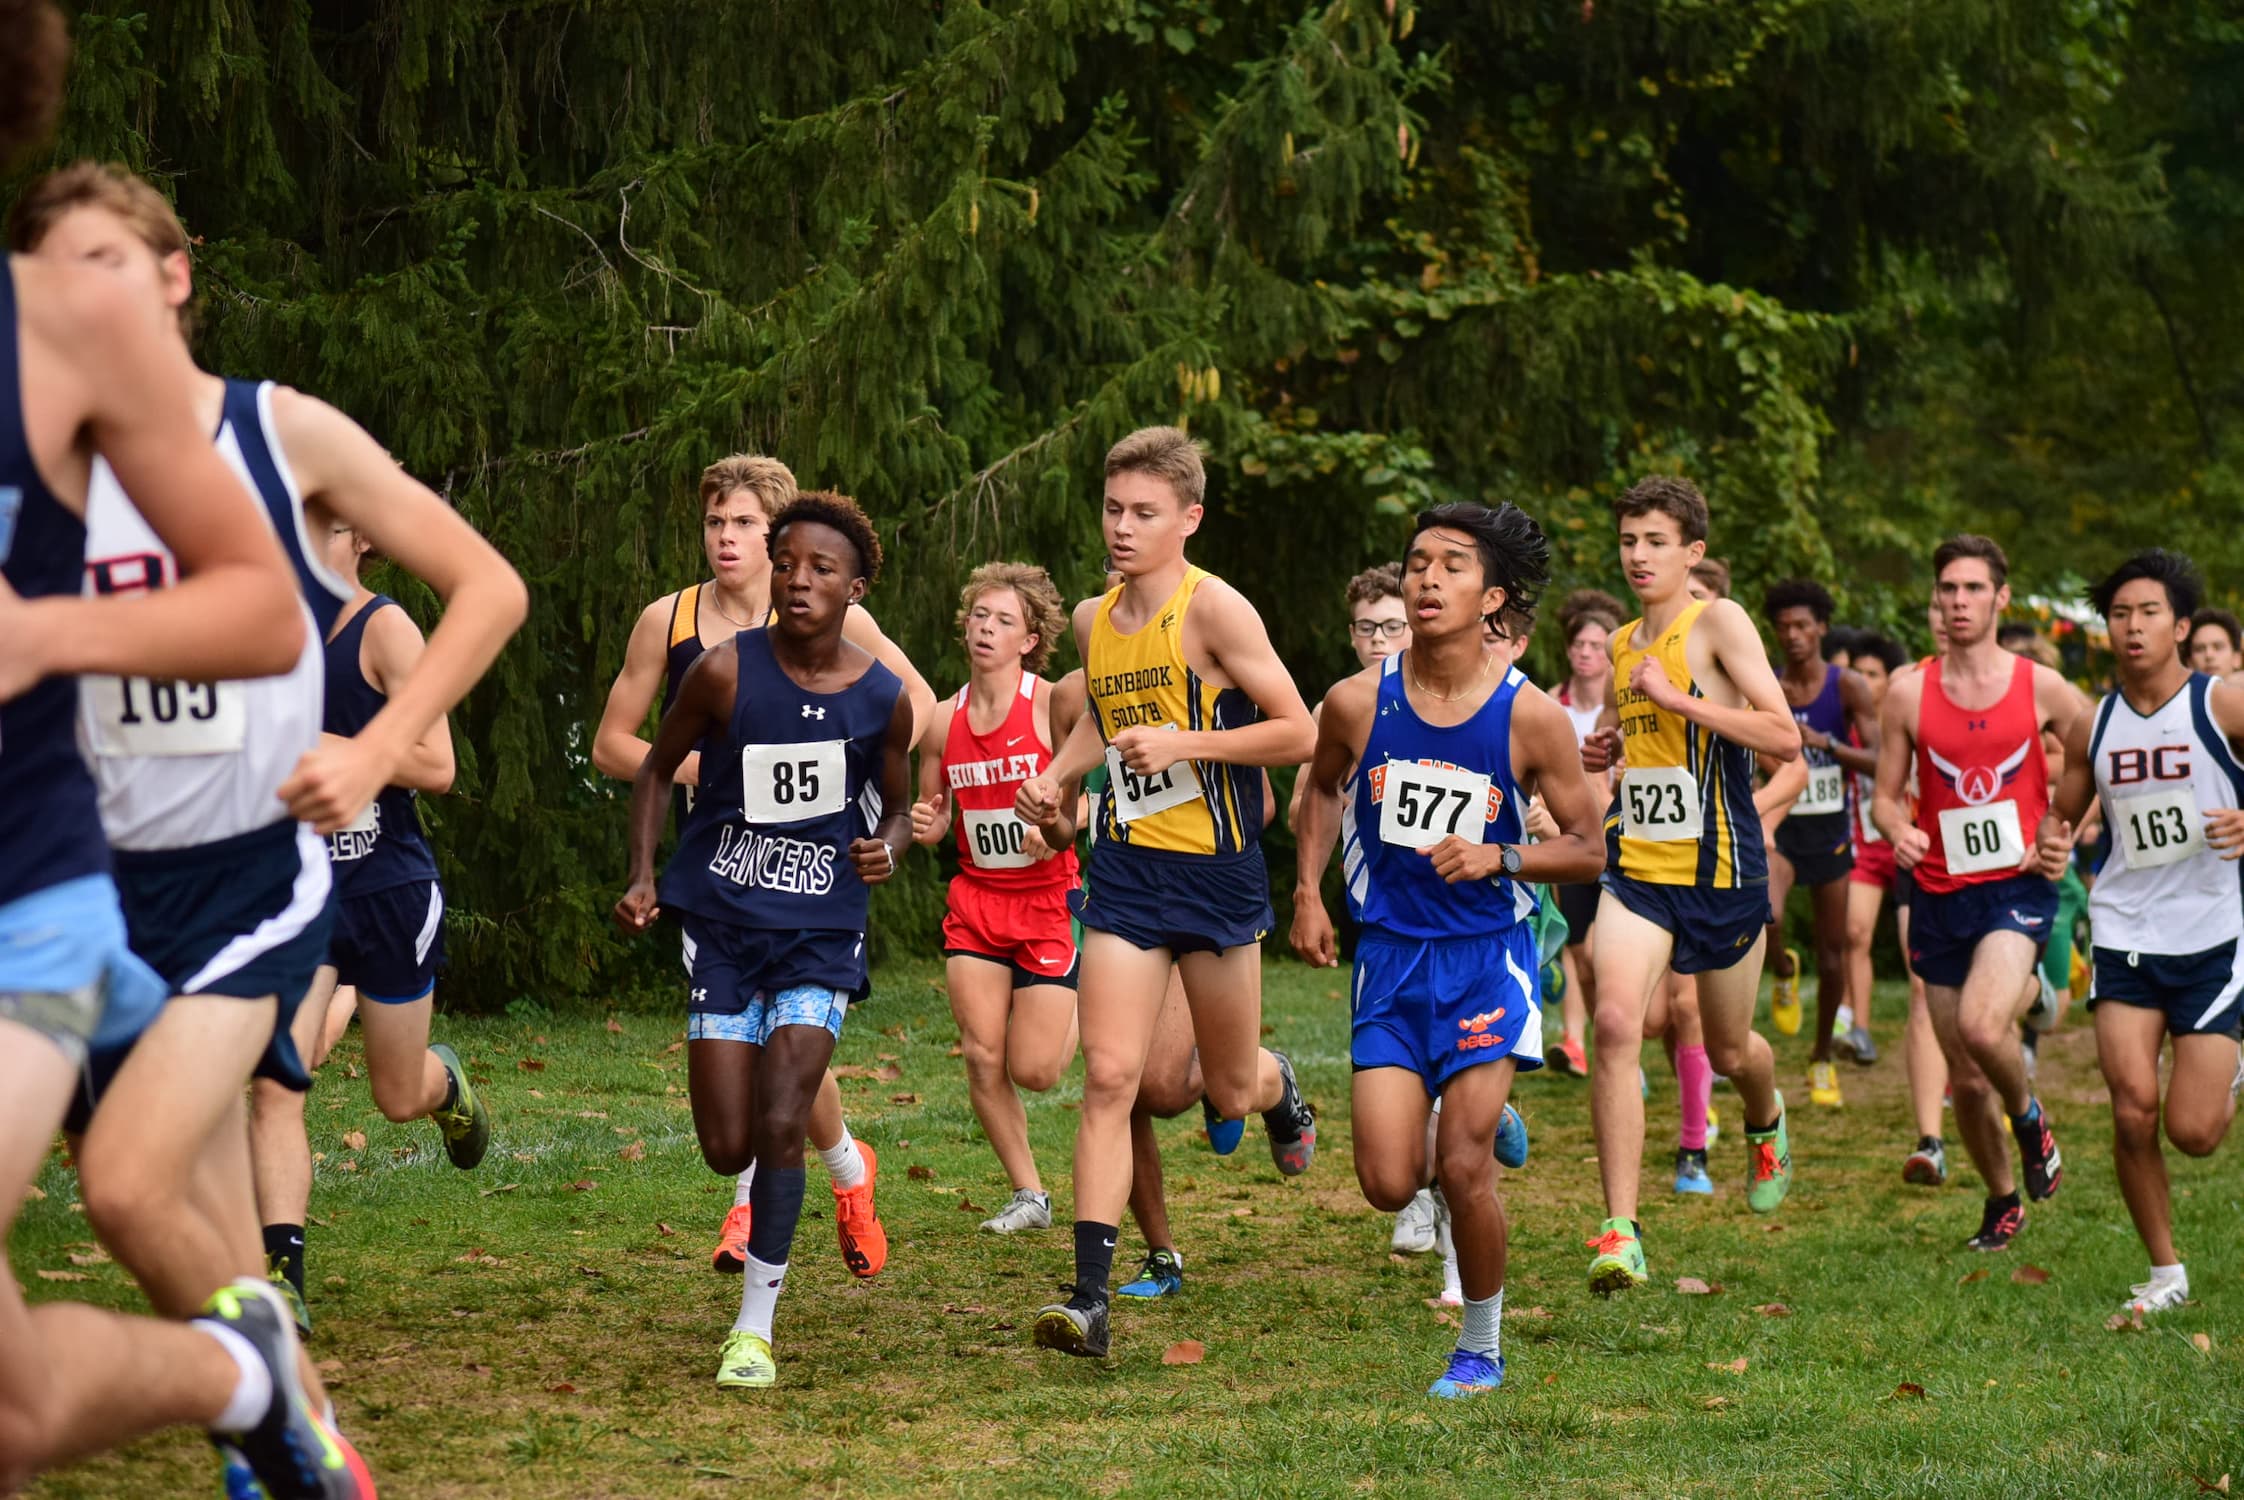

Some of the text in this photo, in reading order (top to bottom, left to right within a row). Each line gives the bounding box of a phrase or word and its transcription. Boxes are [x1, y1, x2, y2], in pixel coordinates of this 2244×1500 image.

[1111, 702, 1162, 729] SOUTH
[773, 760, 819, 804] 85
[947, 753, 1039, 789] HUNTLEY
[2109, 744, 2191, 786] BG
[1397, 781, 1472, 834] 577
[1629, 784, 1686, 824] 523
[975, 821, 1025, 855] 600
[1964, 819, 2001, 856] 60
[2131, 806, 2188, 851] 163
[709, 824, 836, 895] LANCERS
